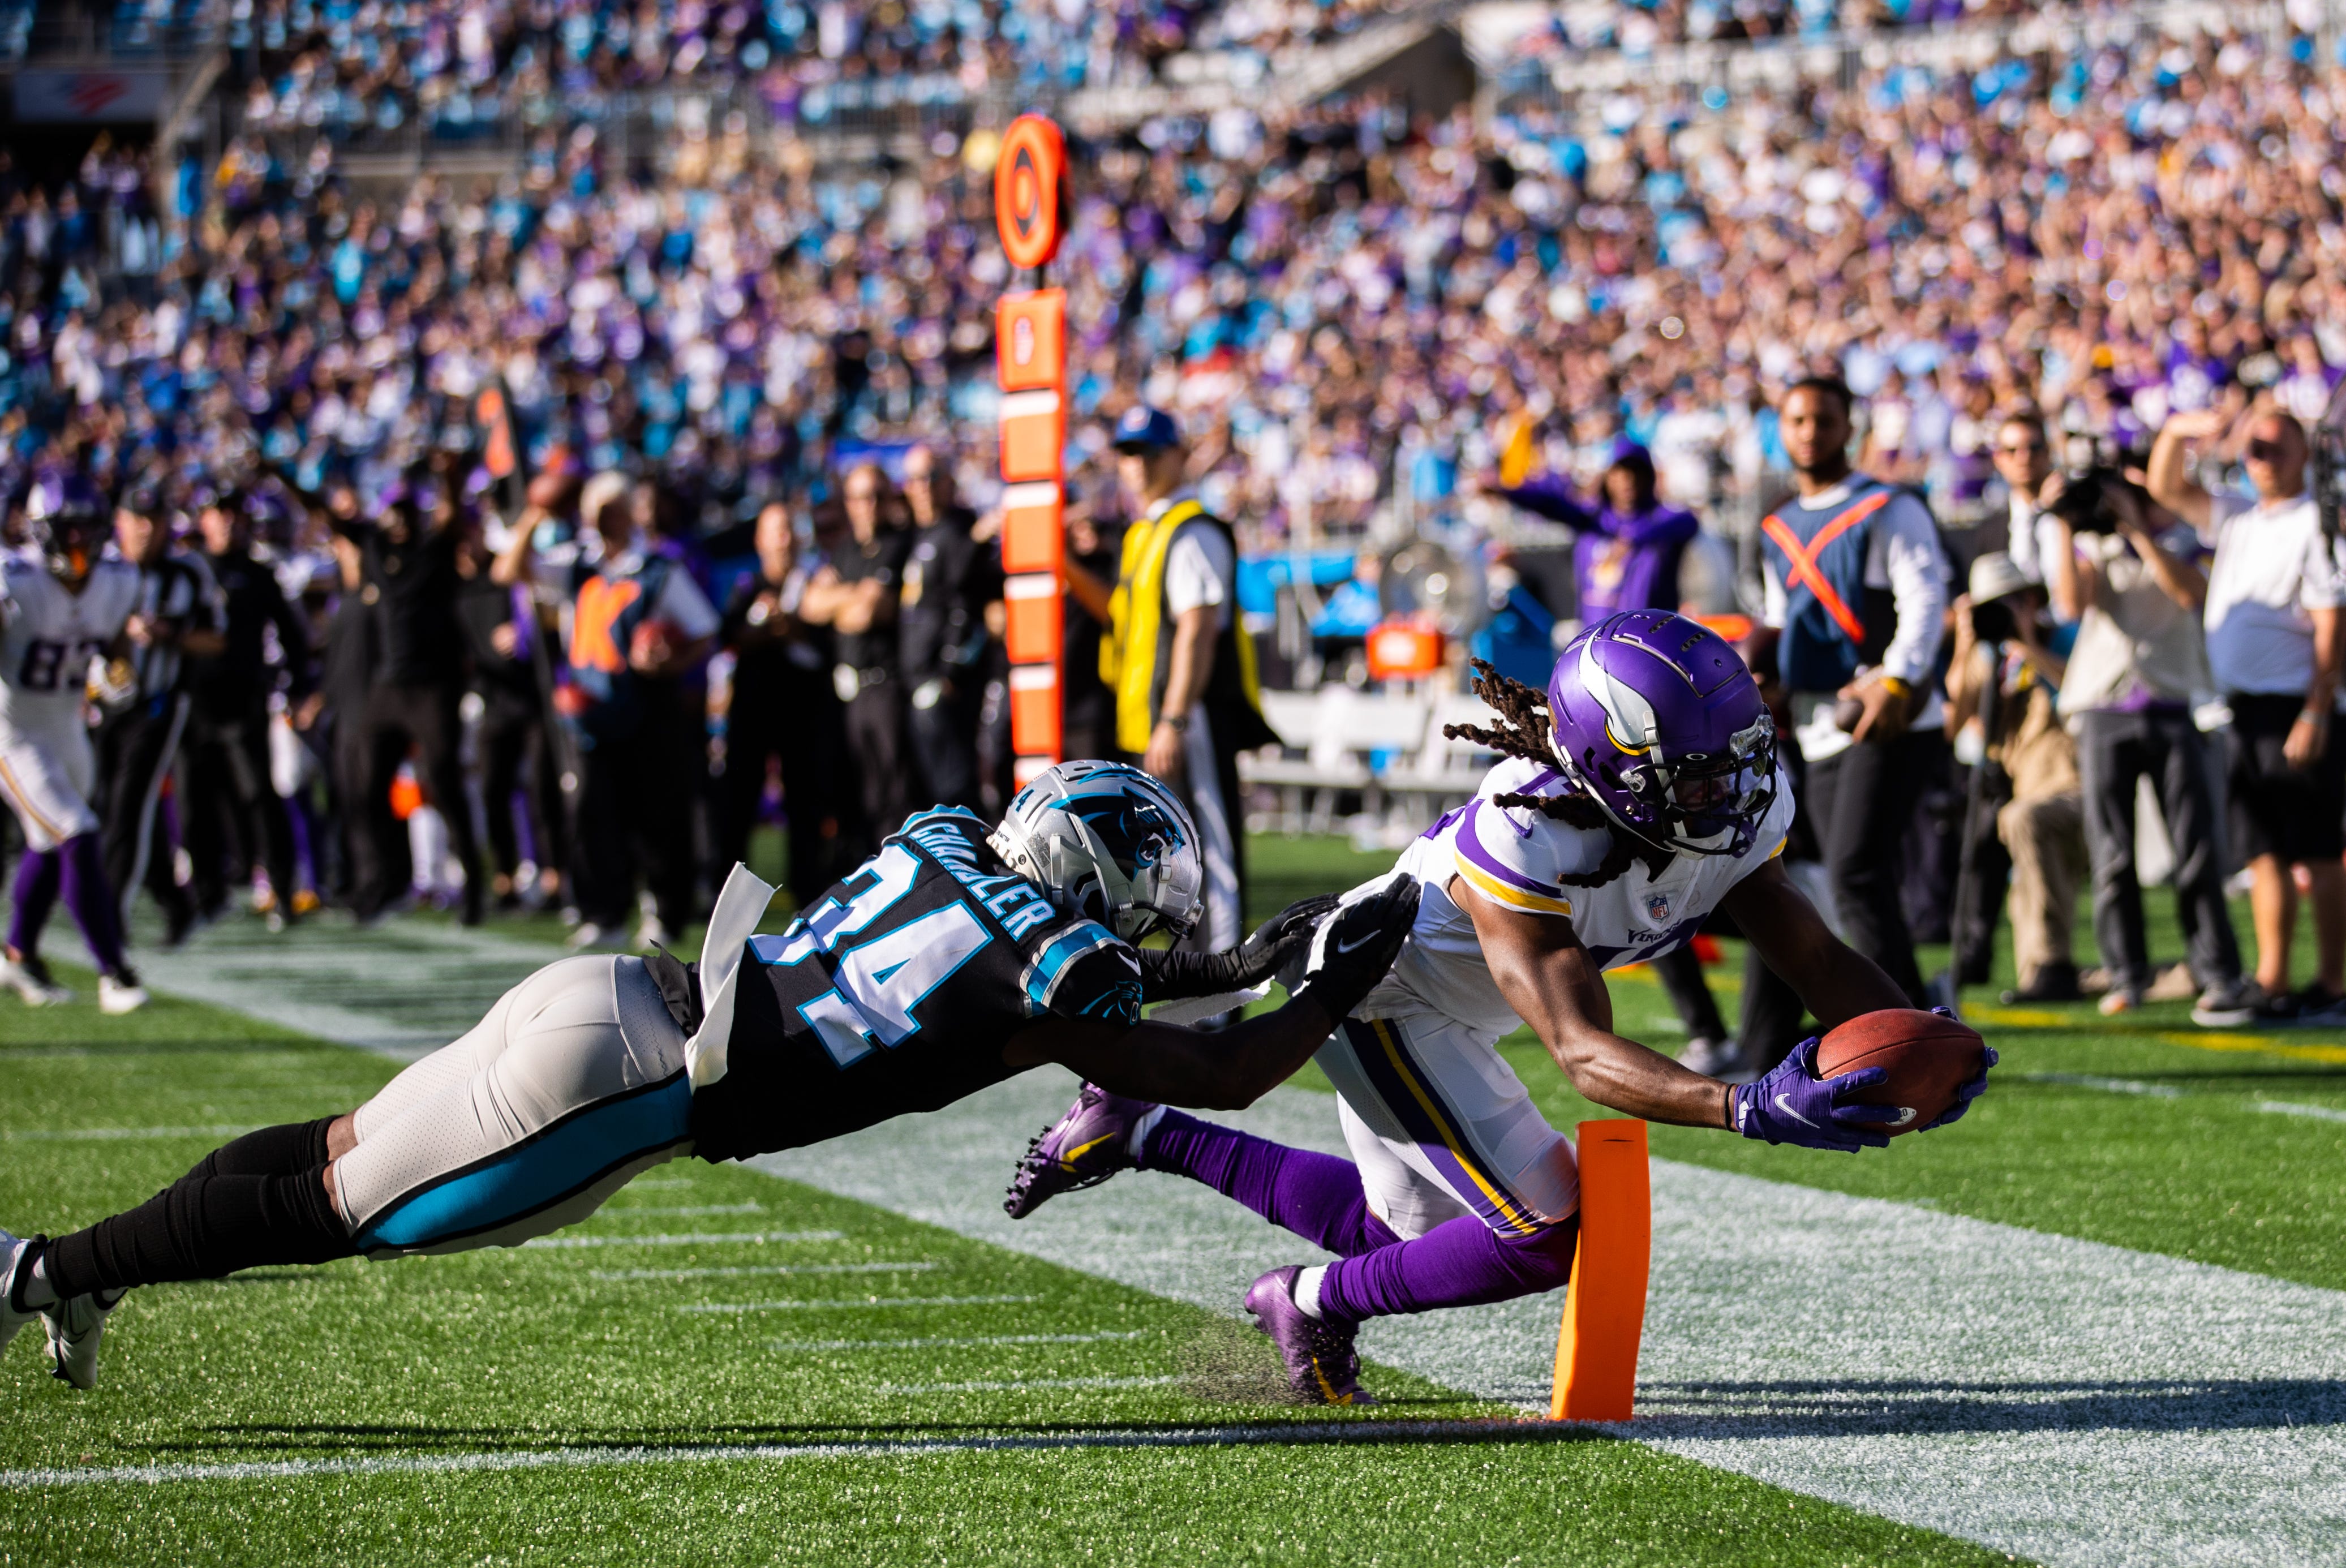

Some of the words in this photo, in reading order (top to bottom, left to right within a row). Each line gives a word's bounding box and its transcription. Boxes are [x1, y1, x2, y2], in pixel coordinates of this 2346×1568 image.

[568, 574, 642, 674] K
[747, 843, 994, 1071] 34
[1652, 906, 1668, 918] NFL
